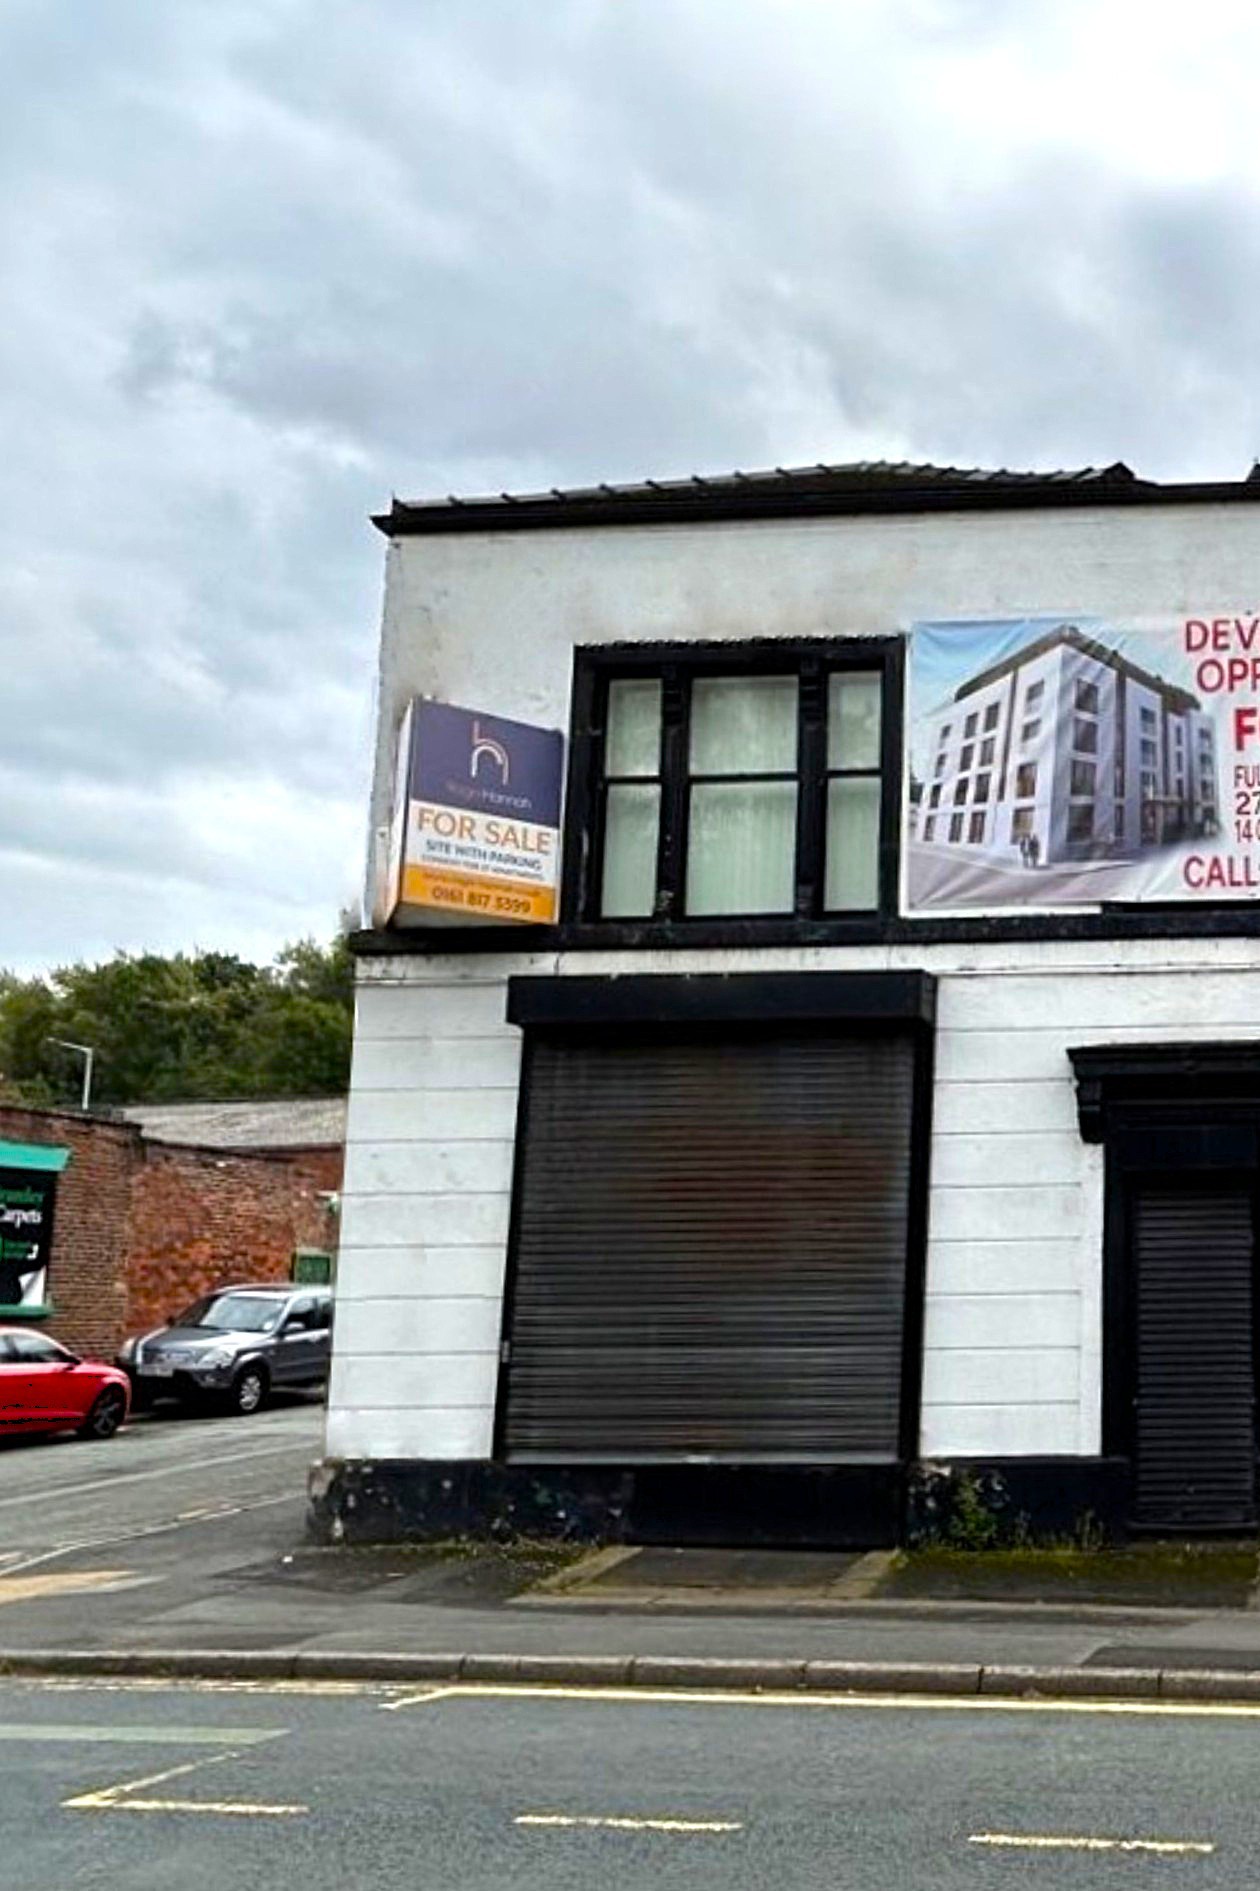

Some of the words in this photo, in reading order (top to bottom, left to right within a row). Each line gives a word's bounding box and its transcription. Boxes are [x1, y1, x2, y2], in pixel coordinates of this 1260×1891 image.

[417, 807, 476, 843] FOR
[485, 822, 551, 856] SALE
[1234, 819, 1254, 843] 14
[426, 839, 451, 855] SITE
[455, 844, 487, 860] WITH
[491, 851, 543, 870] PARKING
